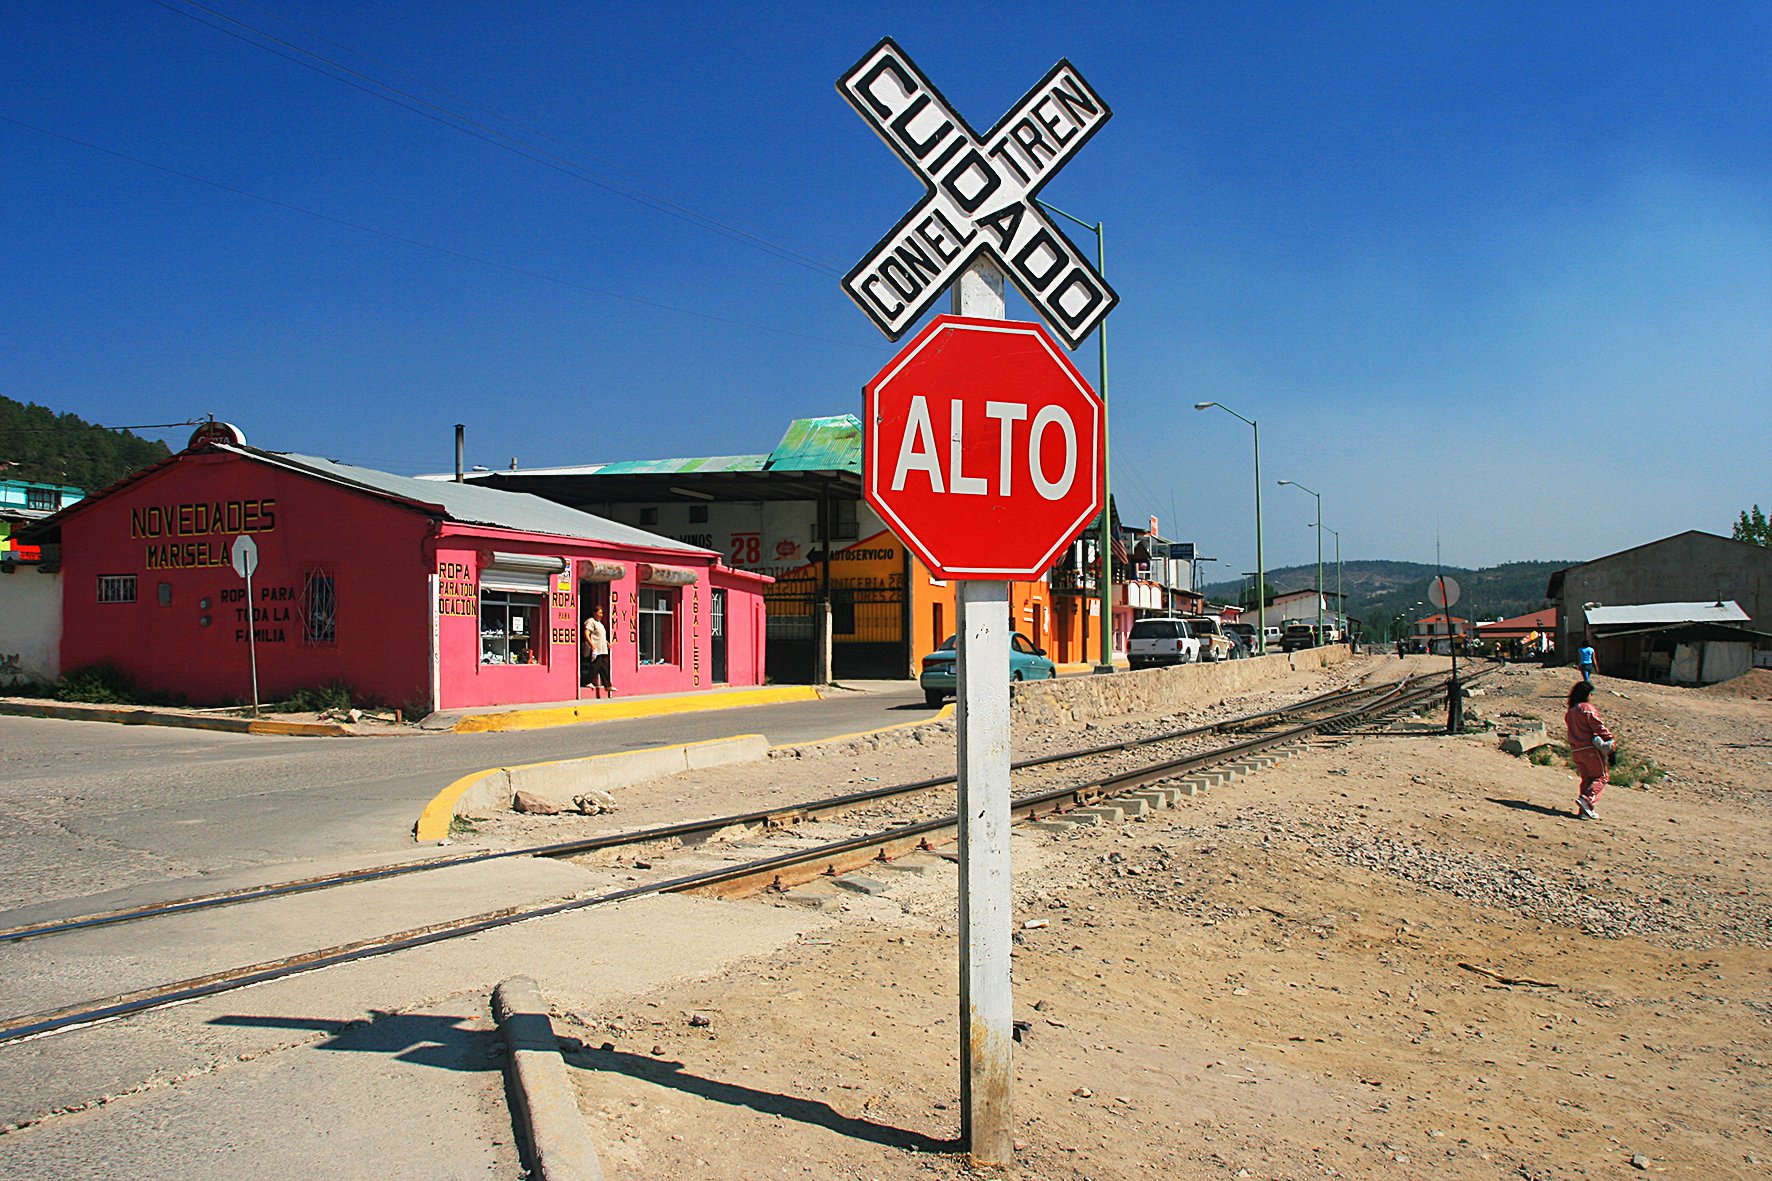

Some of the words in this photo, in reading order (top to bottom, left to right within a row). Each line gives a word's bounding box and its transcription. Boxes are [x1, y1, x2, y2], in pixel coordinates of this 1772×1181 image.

[988, 74, 1099, 184] TREN
[854, 53, 1104, 329] CUIDADO
[891, 395, 1078, 501] ALTO
[131, 499, 276, 539] NOVEDADES
[146, 541, 231, 570] MARISELA
[731, 537, 761, 565] 28
[829, 548, 894, 562] AUTOSERVICIO
[439, 562, 471, 581] ROPA
[221, 588, 252, 603] ROP
[262, 587, 296, 602] PARA
[439, 582, 459, 598] PARA
[459, 583, 477, 599] TODA
[551, 592, 576, 609] ROPA
[273, 607, 290, 622] LA
[551, 628, 576, 645] BEBE
